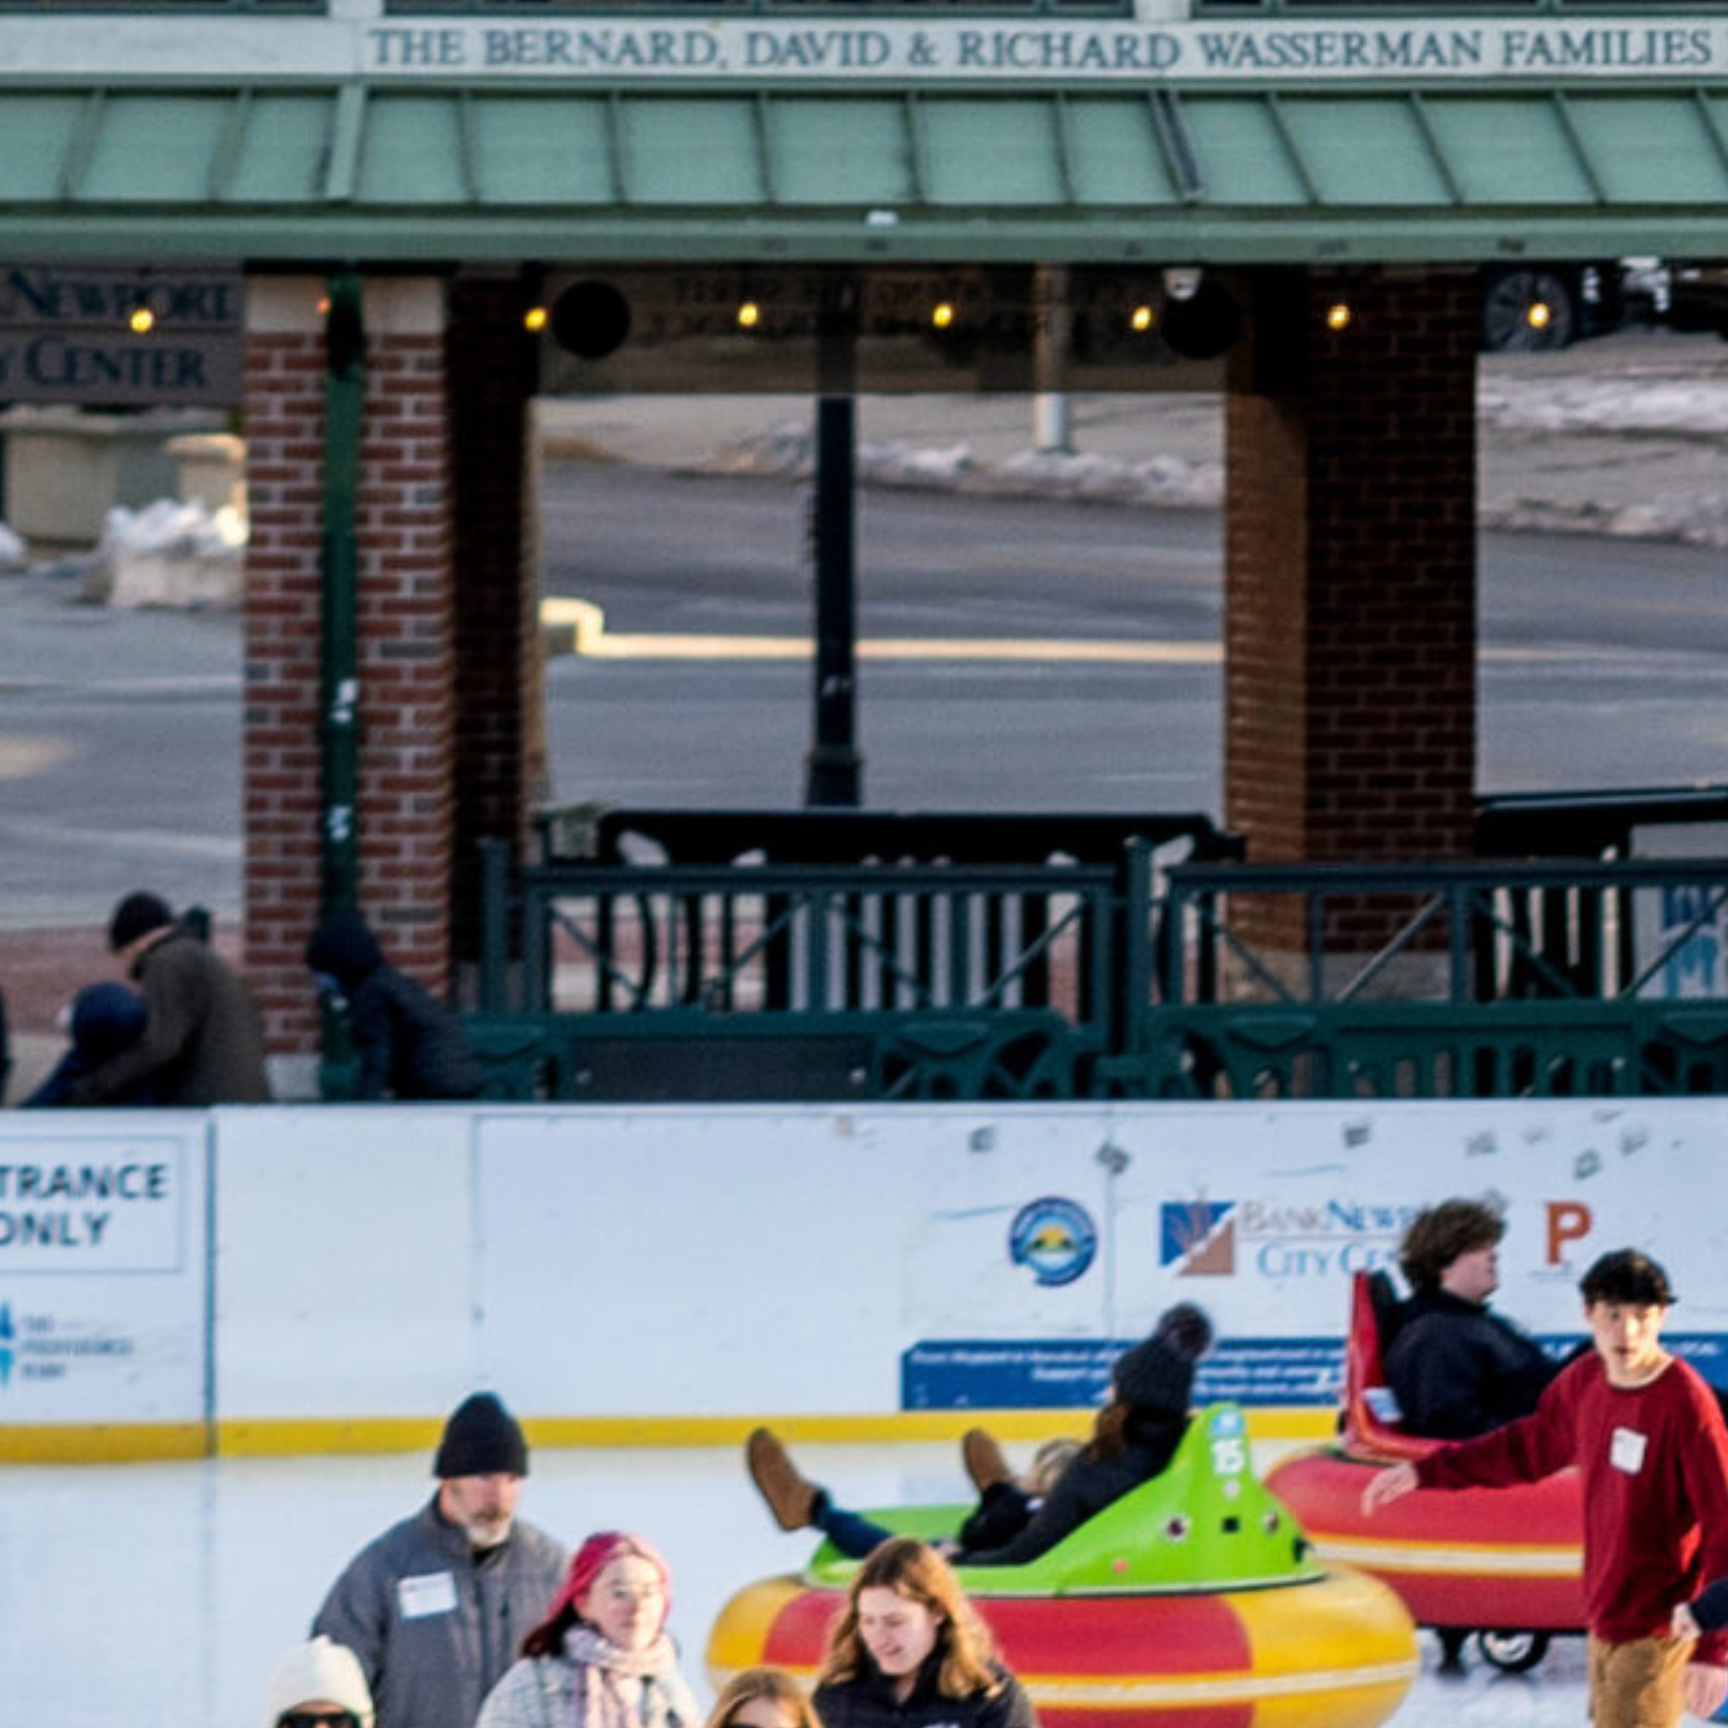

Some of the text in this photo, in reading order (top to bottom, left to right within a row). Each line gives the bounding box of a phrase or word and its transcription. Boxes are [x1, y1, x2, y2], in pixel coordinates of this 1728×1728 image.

[369, 29, 467, 66] THE
[484, 29, 728, 69] BERNARD,
[743, 29, 891, 66] DAVID
[907, 31, 937, 67] &
[957, 31, 1183, 68] RICHARD
[1198, 31, 1480, 68] WASSERMAN
[1501, 30, 1712, 66] FAMILIES
[24, 332, 208, 388] CENTER
[1545, 1201, 1593, 1265] P
[1210, 1439, 1245, 1474] 15
